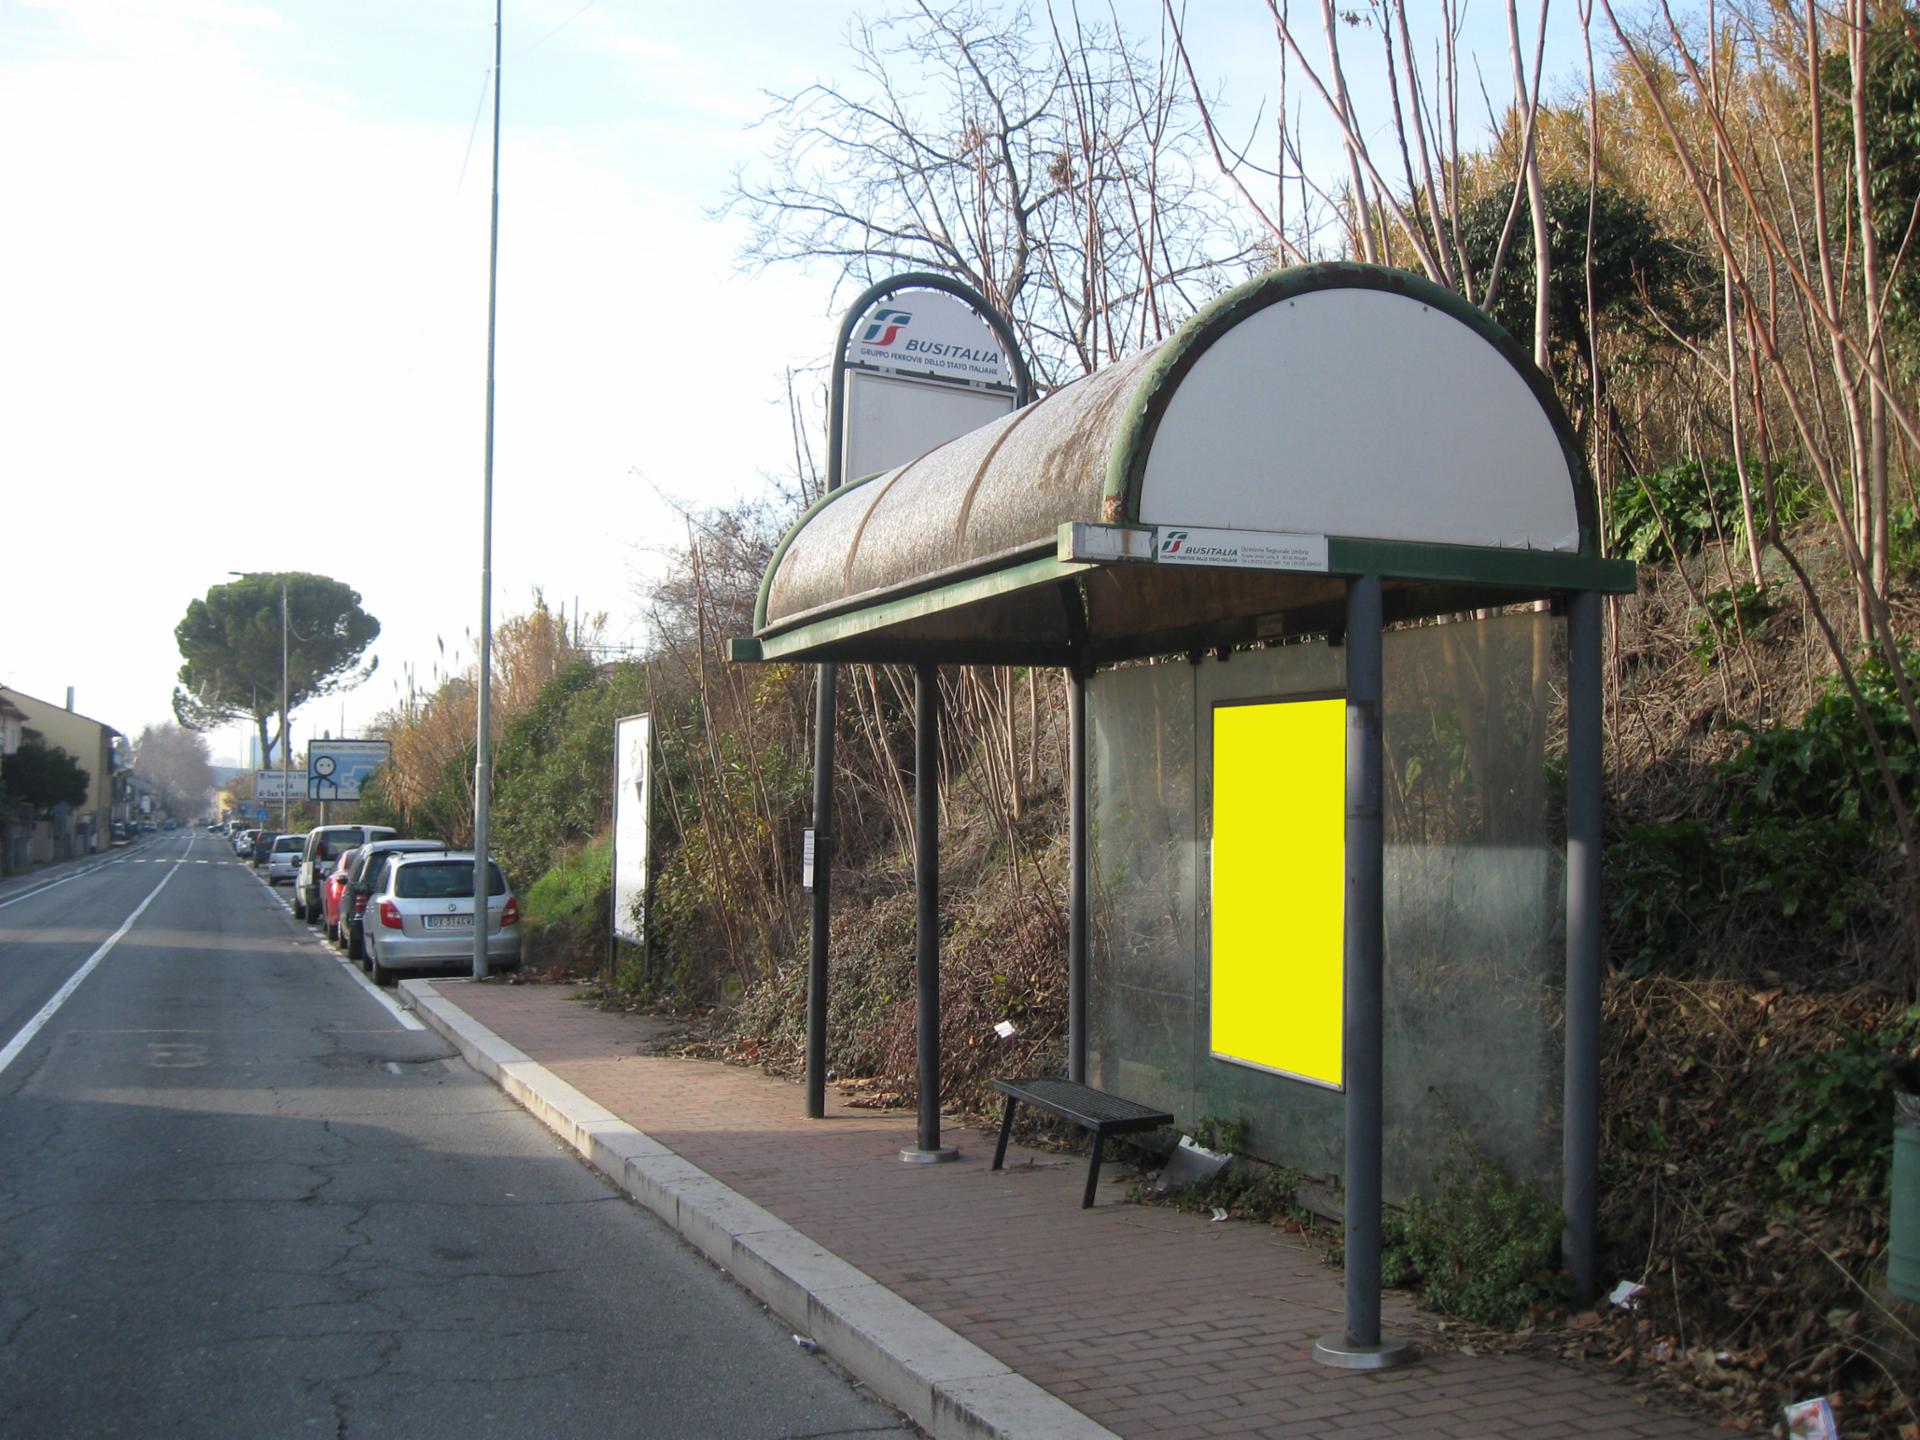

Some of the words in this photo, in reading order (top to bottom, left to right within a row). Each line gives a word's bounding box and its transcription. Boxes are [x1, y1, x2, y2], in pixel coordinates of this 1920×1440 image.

[860, 347, 890, 359] GRUPPO
[891, 352, 923, 364] FERROVIE
[924, 358, 946, 368] DELLO
[947, 361, 968, 371] STATO
[968, 365, 998, 376] ITALIANE
[905, 339, 999, 364] BUSITALIA
[1185, 546, 1238, 556] BUSITALIA
